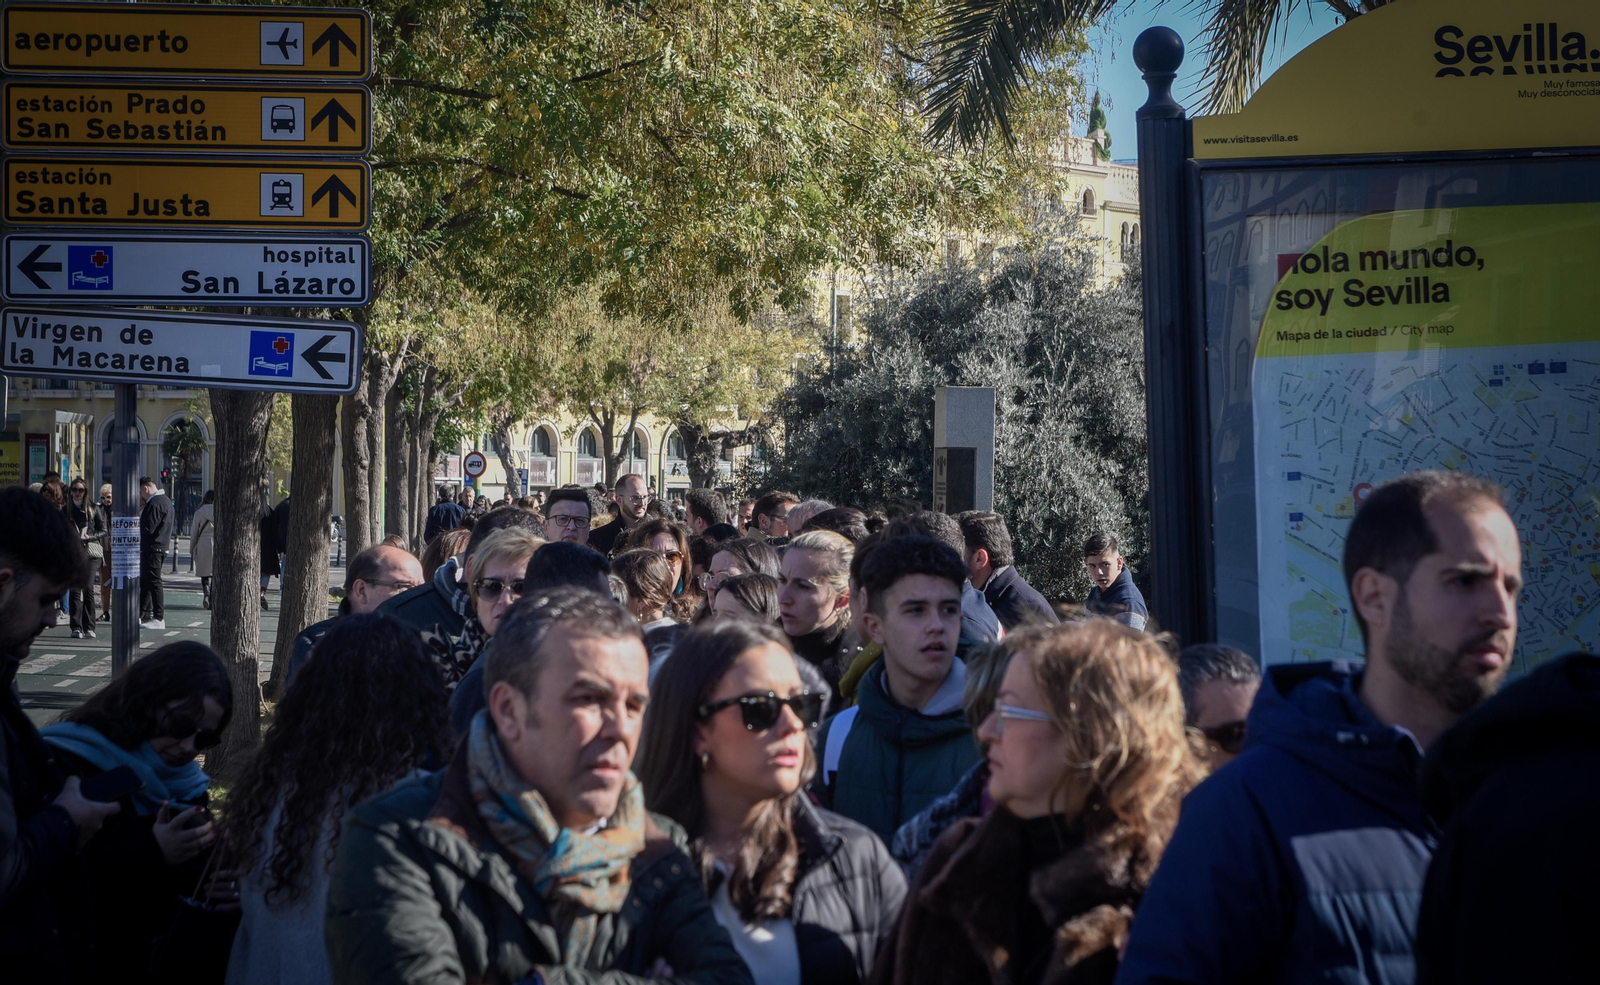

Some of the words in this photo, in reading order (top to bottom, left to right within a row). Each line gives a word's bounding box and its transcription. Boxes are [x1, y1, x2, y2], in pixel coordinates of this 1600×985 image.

[15, 29, 188, 57] aeropuerto
[1518, 90, 1538, 99] Muy
[1540, 88, 1600, 98] desconocida
[1544, 80, 1563, 89] Muy
[1566, 79, 1600, 88] famosa
[16, 95, 113, 113] estación
[127, 93, 206, 115] Prado
[16, 117, 70, 139] San
[86, 118, 226, 141] Sebastián
[1203, 134, 1298, 144] www.visitasevilla.es
[15, 167, 112, 186] estación
[15, 190, 108, 215] Santa
[127, 193, 211, 217] Justa
[263, 246, 356, 266] hospital
[1359, 240, 1485, 271] mundo,
[181, 270, 240, 294] San
[257, 270, 356, 296] Lázaro
[1275, 287, 1335, 317] soy
[1343, 276, 1451, 308] Sevilla
[13, 316, 103, 344] Virgen
[120, 323, 154, 345] de
[1276, 330, 1311, 342] Mapa
[1313, 328, 1329, 340] de
[1332, 328, 1343, 339] la
[1345, 326, 1388, 338] ciudad
[1401, 324, 1425, 337] City
[1427, 324, 1455, 336] map
[10, 342, 35, 365] la
[52, 345, 190, 374] Macarena
